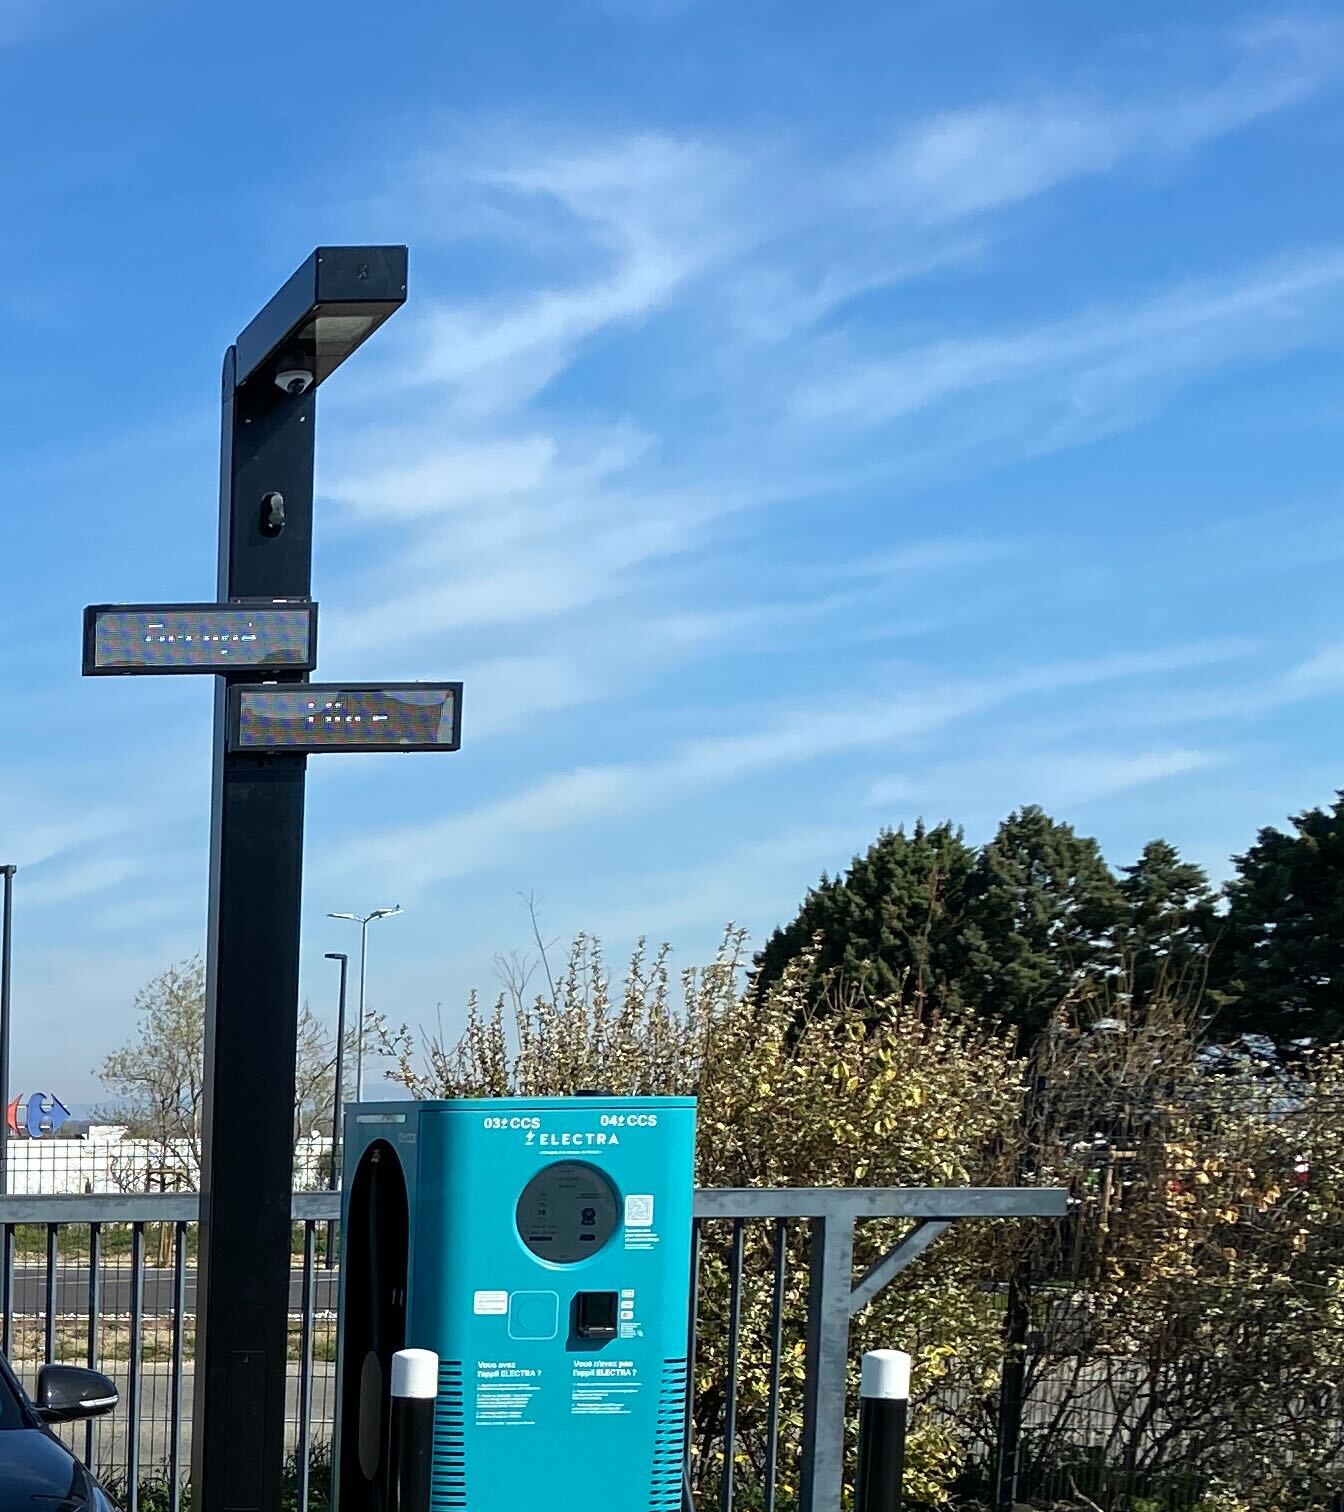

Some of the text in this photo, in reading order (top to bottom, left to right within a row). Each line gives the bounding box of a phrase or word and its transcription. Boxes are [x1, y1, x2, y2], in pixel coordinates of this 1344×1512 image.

[483, 1117, 541, 1129] 03 CCS
[600, 1114, 658, 1127] 04 CCS
[539, 1133, 620, 1146] ELECTRA
